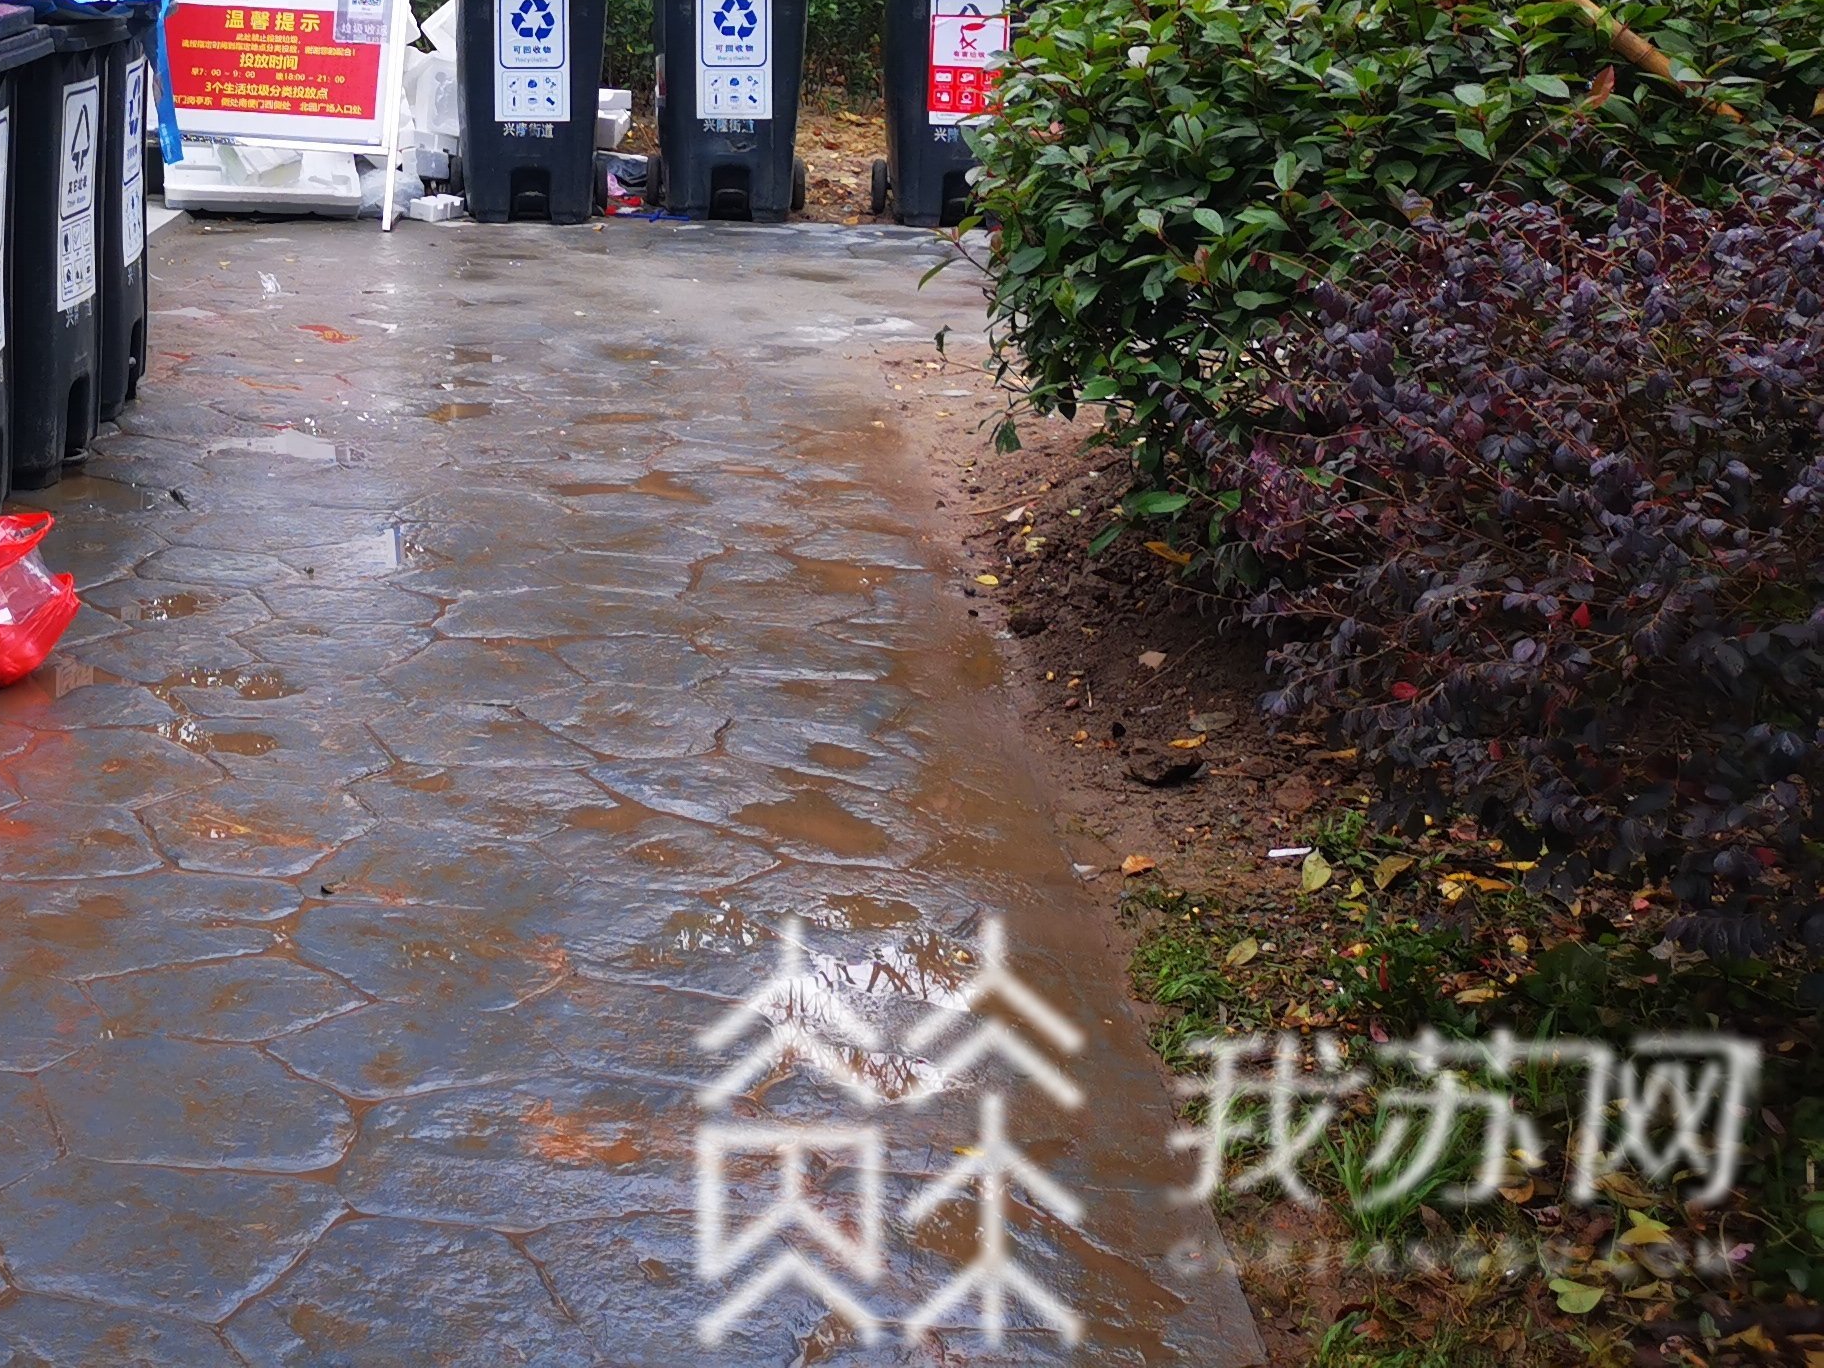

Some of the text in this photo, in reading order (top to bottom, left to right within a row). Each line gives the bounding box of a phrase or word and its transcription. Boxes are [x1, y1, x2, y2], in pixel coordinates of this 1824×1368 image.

[225, 9, 321, 32] 温馨提示
[513, 45, 551, 55] 可回收物
[239, 53, 299, 70] 投放时间
[205, 81, 329, 99] 3个生活垃圾分类投放点
[503, 122, 554, 139] 兴隆街道
